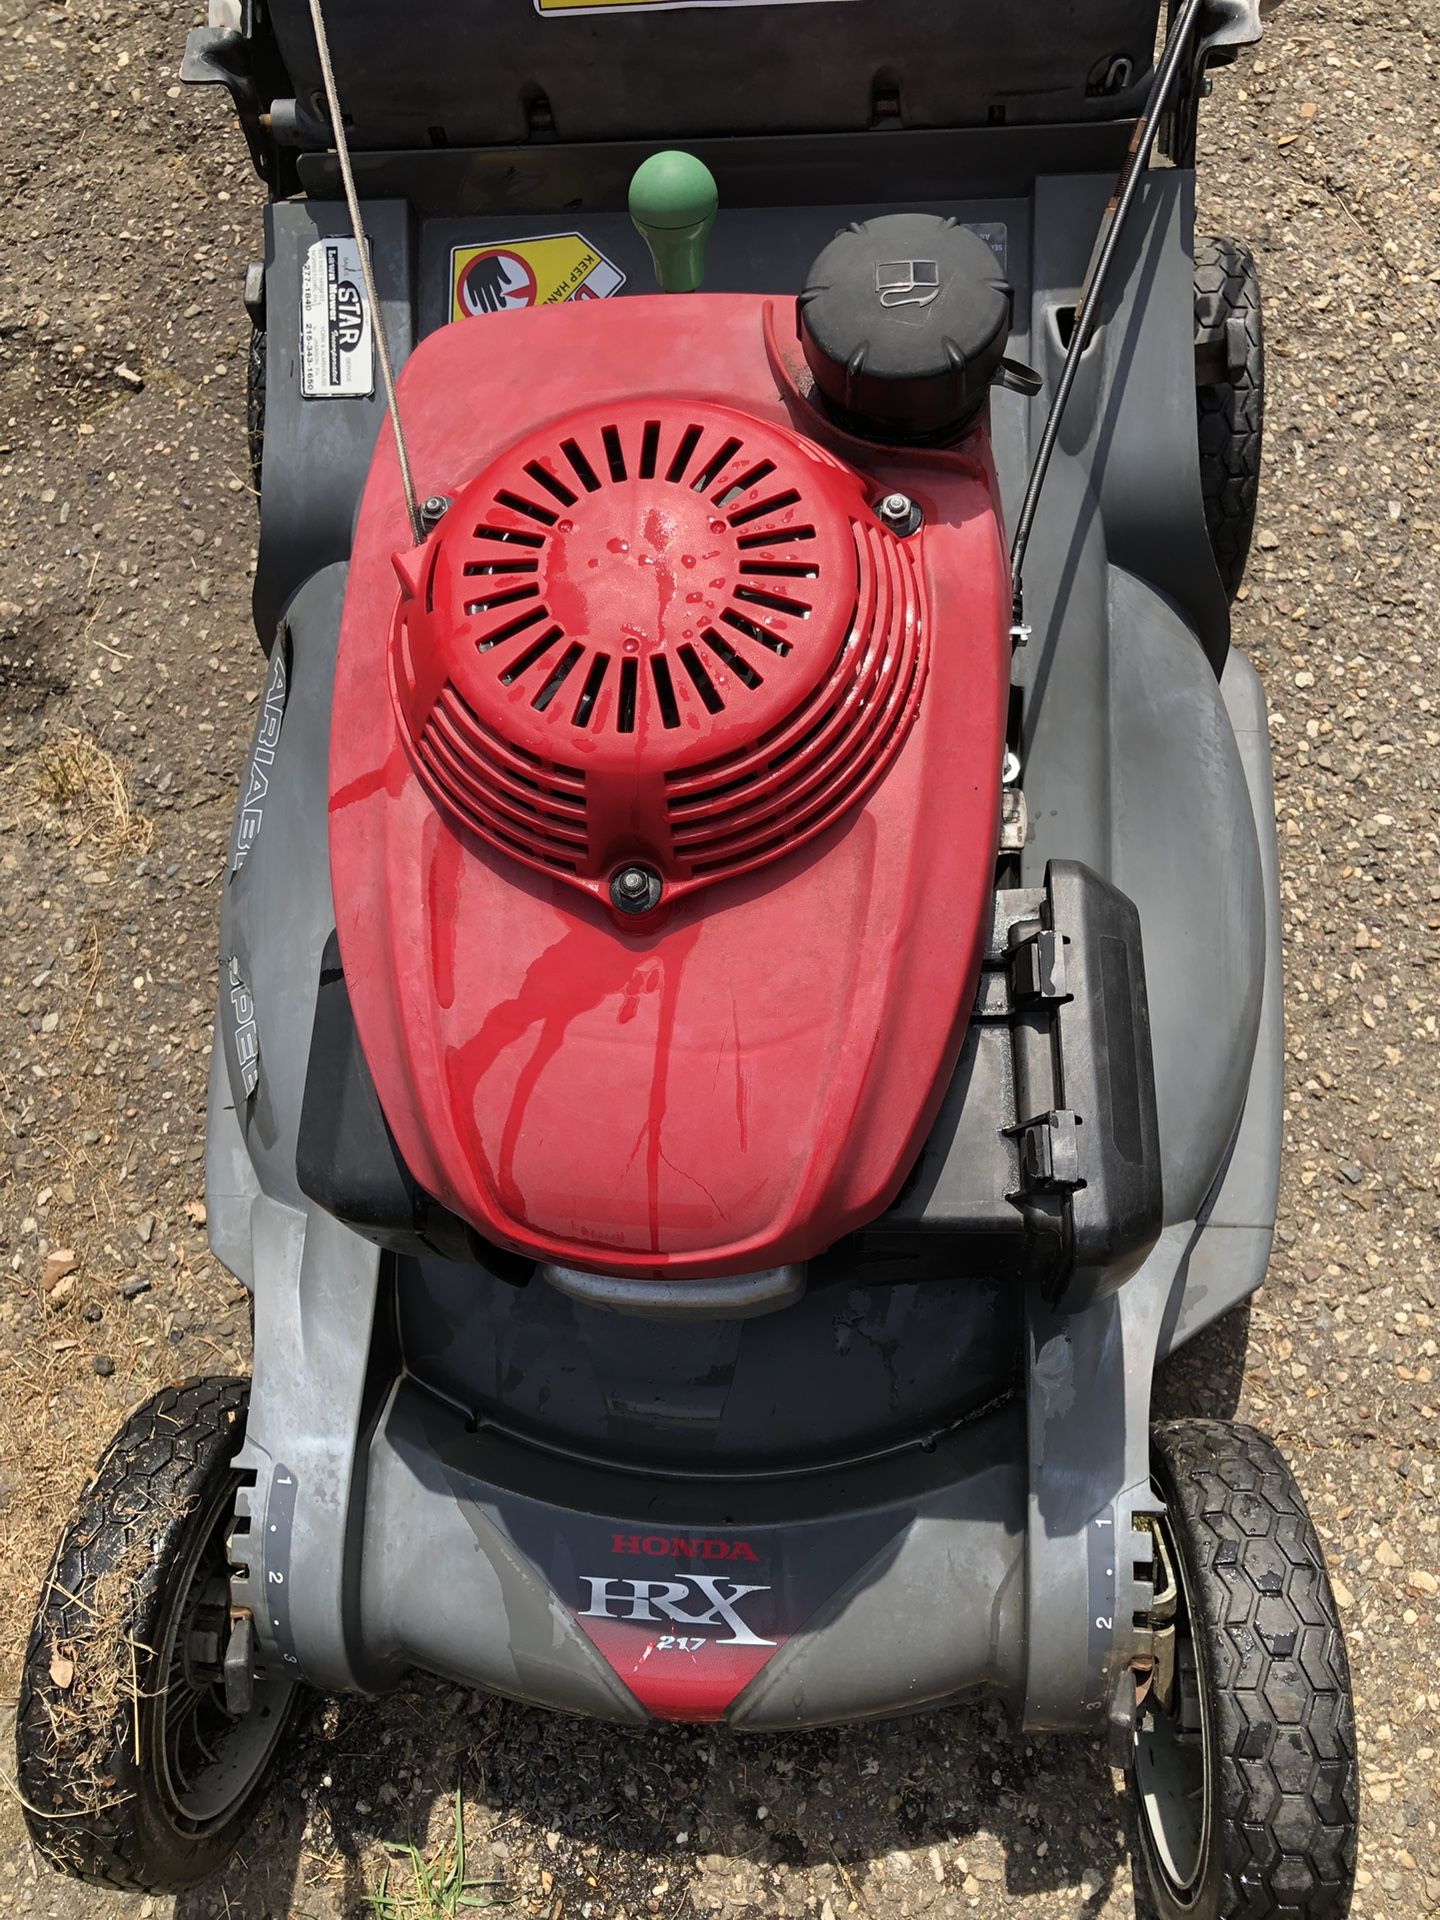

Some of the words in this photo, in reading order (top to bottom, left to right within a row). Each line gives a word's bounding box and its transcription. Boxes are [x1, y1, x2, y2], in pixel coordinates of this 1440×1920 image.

[328, 250, 336, 281] Lawn
[570, 254, 594, 282] KEEP
[329, 283, 338, 322] Mower
[543, 281, 570, 304] HAN
[338, 287, 362, 345] STAR
[306, 323, 314, 391] 215-343-1650
[330, 329, 339, 384] Incorporated
[277, 1476, 292, 1484] 1
[1095, 1519, 1112, 1528] 1
[612, 1534, 759, 1562] HONDA
[269, 1571, 284, 1584] 2
[578, 1573, 777, 1646] HRX
[1095, 1616, 1112, 1629] 2
[656, 1635, 706, 1651] 217
[283, 1653, 297, 1664] 3
[1086, 1700, 1101, 1710] 3
